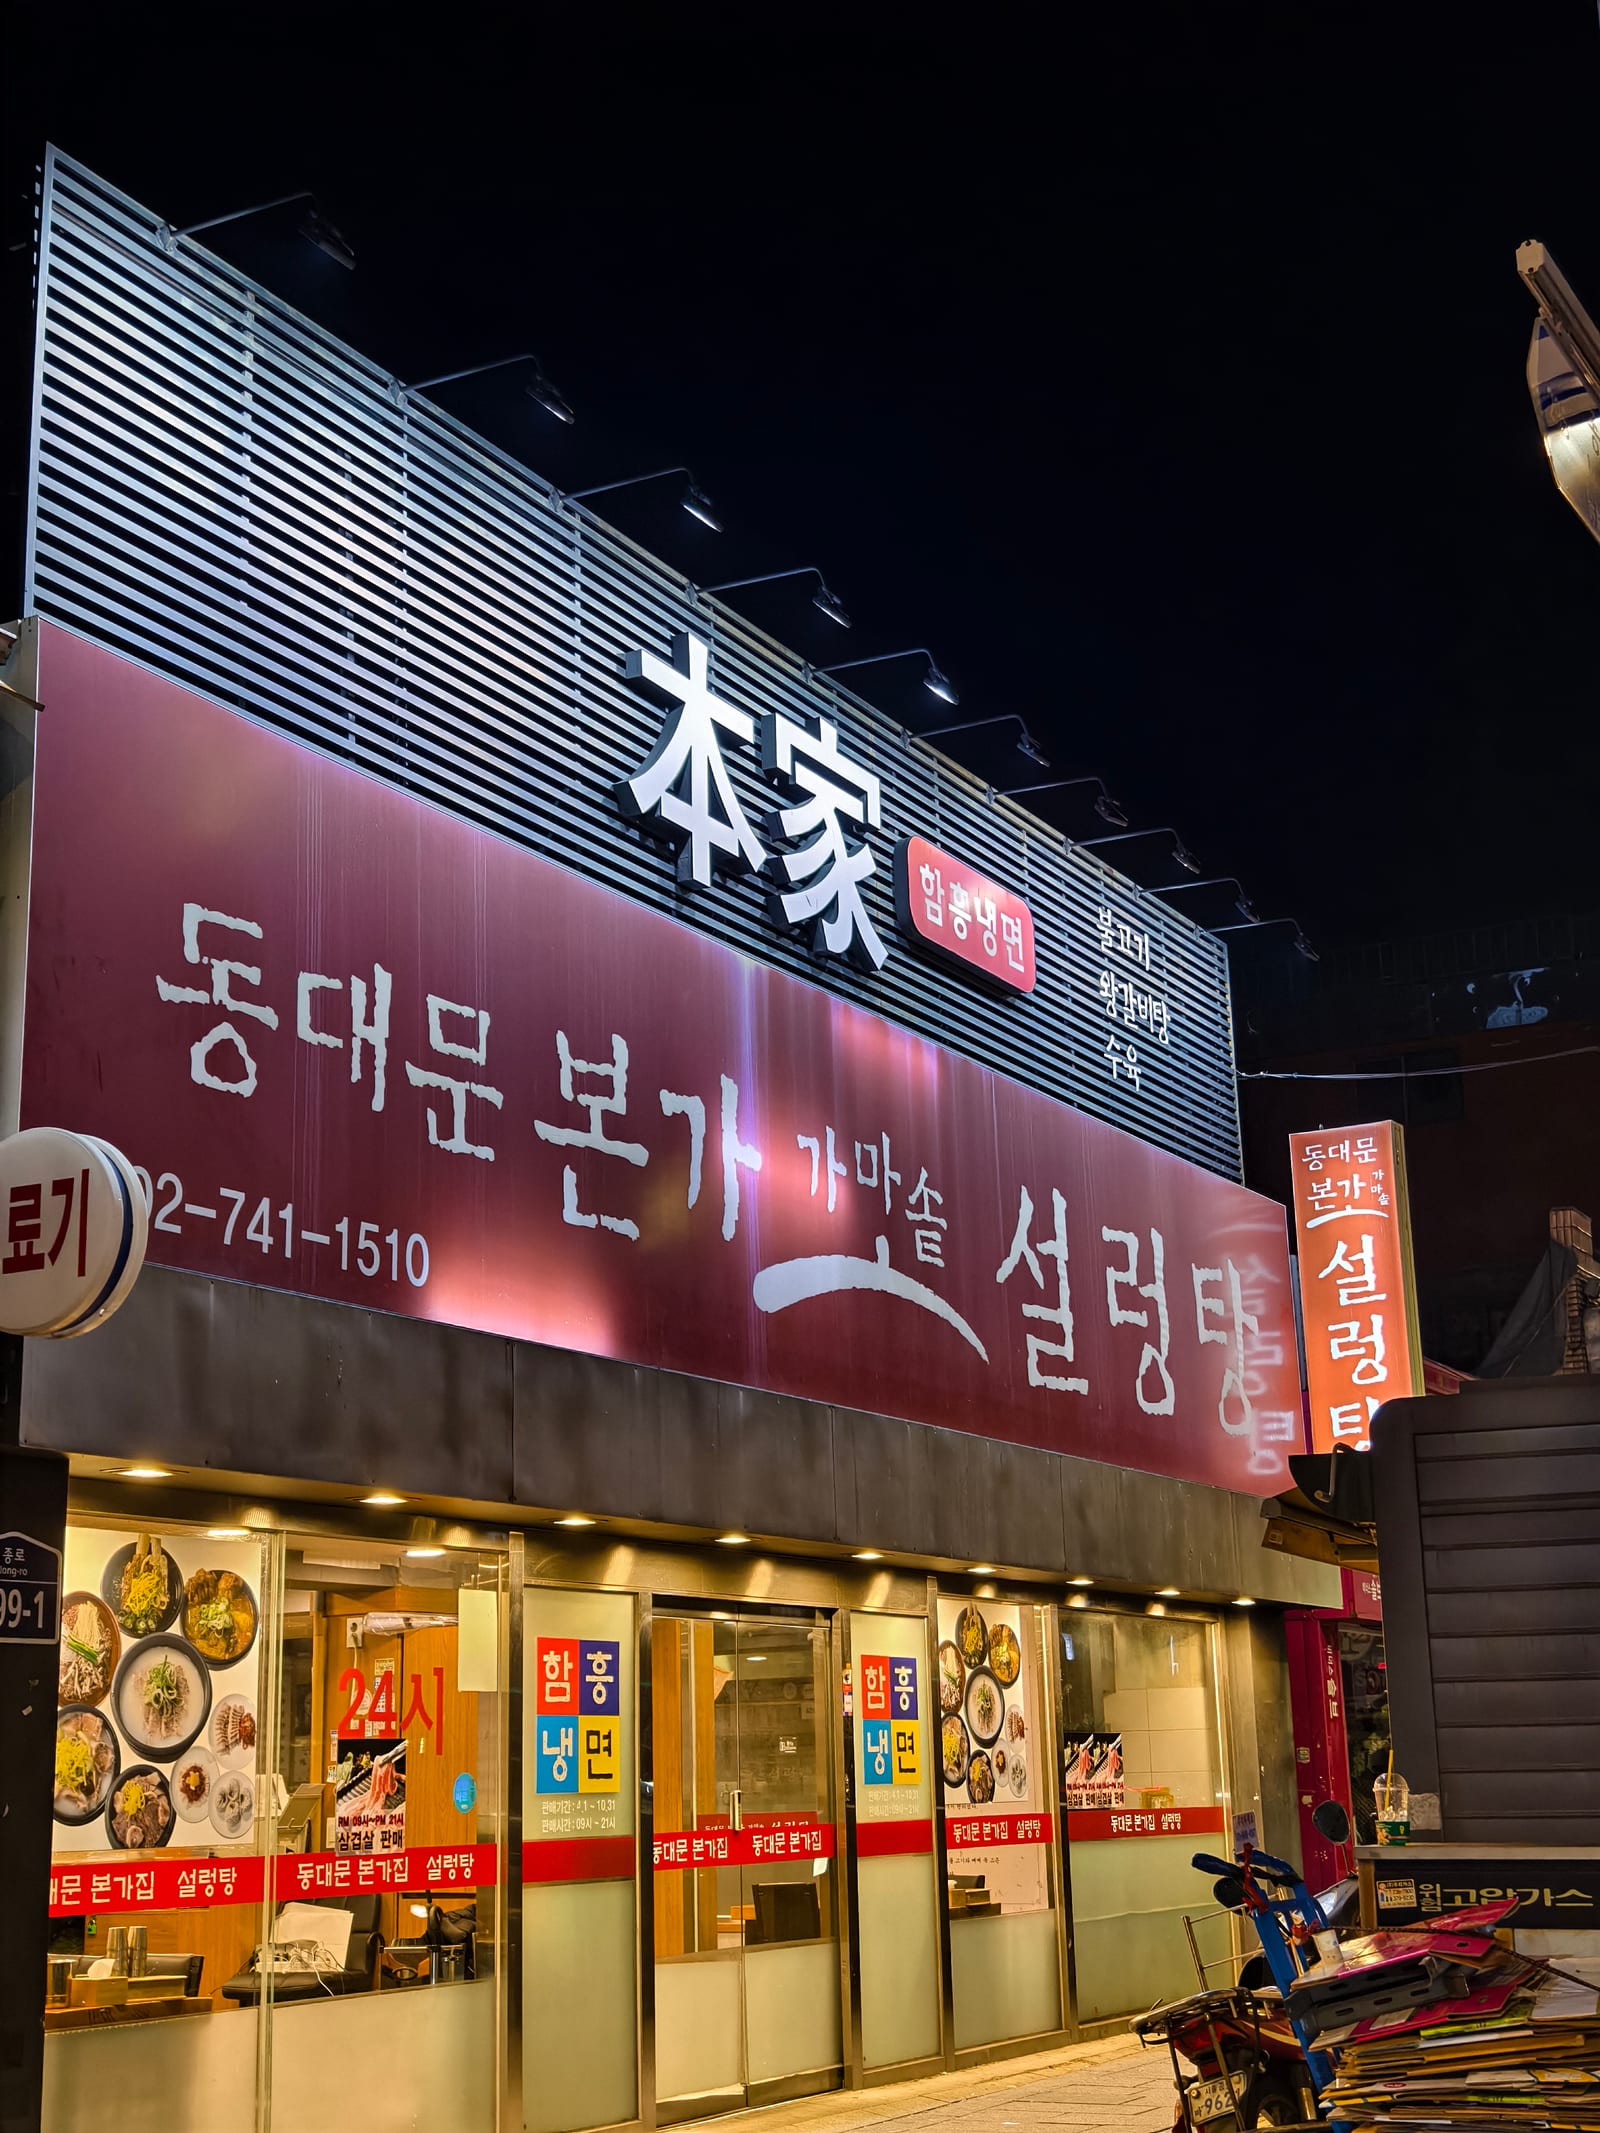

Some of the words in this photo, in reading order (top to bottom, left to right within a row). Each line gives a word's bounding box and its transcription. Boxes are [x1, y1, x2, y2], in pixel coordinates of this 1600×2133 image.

[612, 632, 890, 972] 本家
[919, 864, 1025, 973] 함흥냉면
[1097, 907, 1150, 971] 불고기
[1100, 970, 1171, 1044] 왕갈비탕
[1104, 1035, 1142, 1092] 수육
[156, 903, 503, 1162] 동대문
[533, 1030, 762, 1242] 본가
[798, 1126, 947, 1268] 가마솥
[996, 1185, 1259, 1436] 설렁탕
[1302, 1137, 1378, 1171] 동대문
[1307, 1173, 1367, 1211] 본가
[1370, 1169, 1390, 1206] 가마솥
[2, 1168, 90, 1278] 료기
[0, 1567, 28, 1577] ong-ro
[2, 1547, 25, 1565] 종로
[338, 1667, 444, 1755] 24시
[338, 1830, 375, 1851] 삼겹살
[380, 1829, 403, 1849] 판매
[953, 1822, 980, 1844] 동대문
[982, 1820, 1009, 1841] 본가집
[1016, 1818, 1042, 1839] 설렁탕
[1110, 1814, 1133, 1833] 동대문
[1134, 1813, 1156, 1831] 본가집
[1161, 1812, 1182, 1830] 설렁탕
[653, 1838, 688, 1864] 동대문
[692, 1836, 728, 1860] 본가집
[752, 1832, 786, 1857] 동대문
[789, 1829, 822, 1853] 본가집
[91, 1871, 155, 1904] 본가집
[177, 1867, 238, 1898] 설렁탕
[296, 1859, 352, 1891] 동대문
[357, 1856, 409, 1886] 본가집
[426, 1852, 475, 1881] 설렁탕
[1418, 1883, 1443, 1912] 위험
